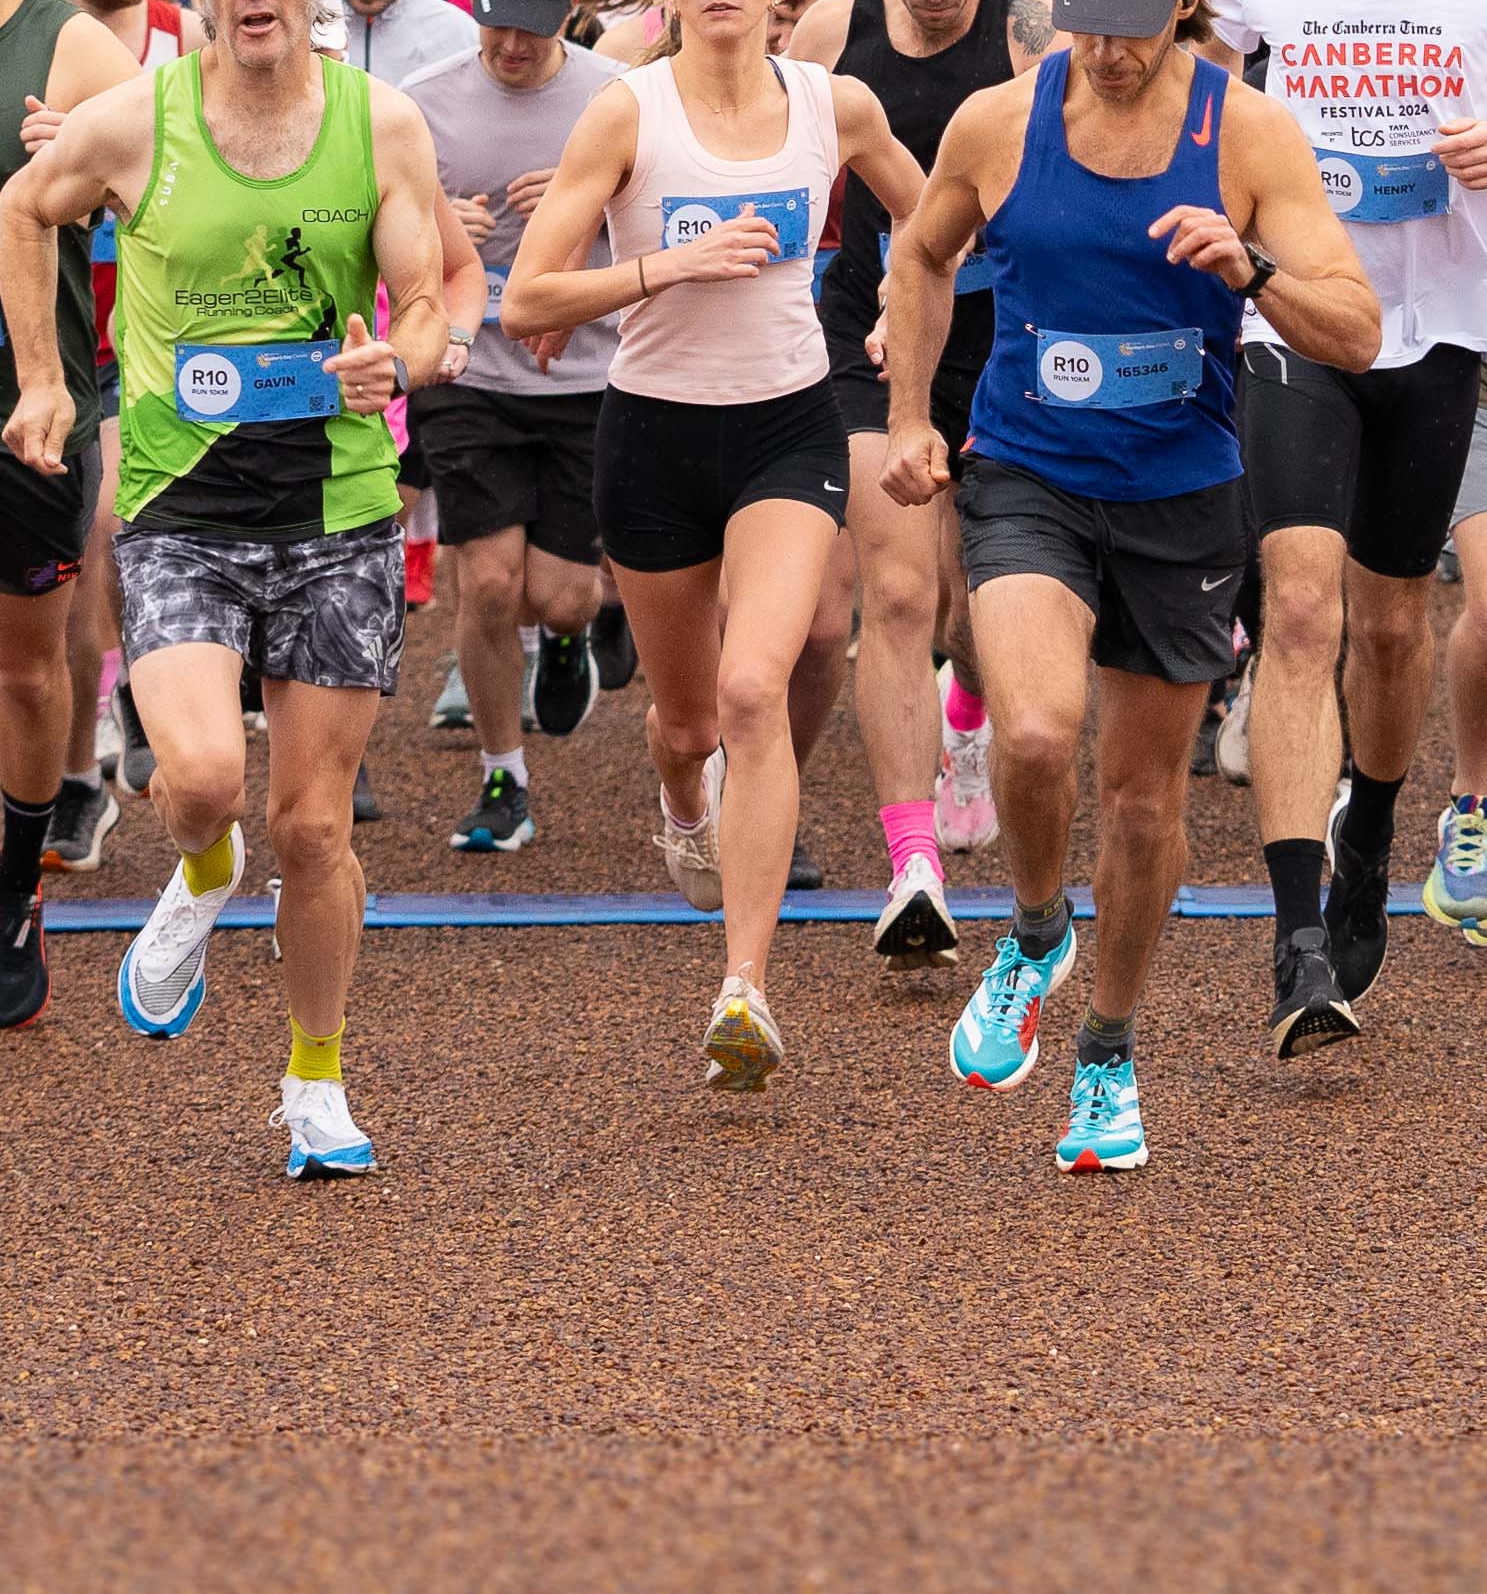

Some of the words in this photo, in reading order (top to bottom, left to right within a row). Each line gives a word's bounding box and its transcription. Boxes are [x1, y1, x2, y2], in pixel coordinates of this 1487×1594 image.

[1302, 20, 1328, 36] The
[1332, 20, 1396, 35] Canberra
[1400, 20, 1442, 36] Times
[1281, 43, 1462, 68] CANBERRA
[1286, 75, 1464, 98] MARATHON
[1321, 106, 1394, 118] FESTIVAL
[1399, 104, 1429, 117] 2024
[1352, 126, 1385, 147] tcs
[1389, 128, 1437, 140] CONSULTANCY
[1321, 171, 1351, 188] R10
[1374, 183, 1416, 195] HENRY
[302, 209, 369, 223] COACH
[678, 220, 712, 235] R10
[175, 287, 313, 308] Eager2Elite
[197, 306, 253, 317] Running
[255, 305, 300, 316] Coach
[1053, 357, 1090, 374] R10
[1116, 362, 1169, 378] 165346
[192, 369, 228, 386] R10
[254, 376, 296, 390] GAVIN
[1053, 374, 1069, 382] RUN
